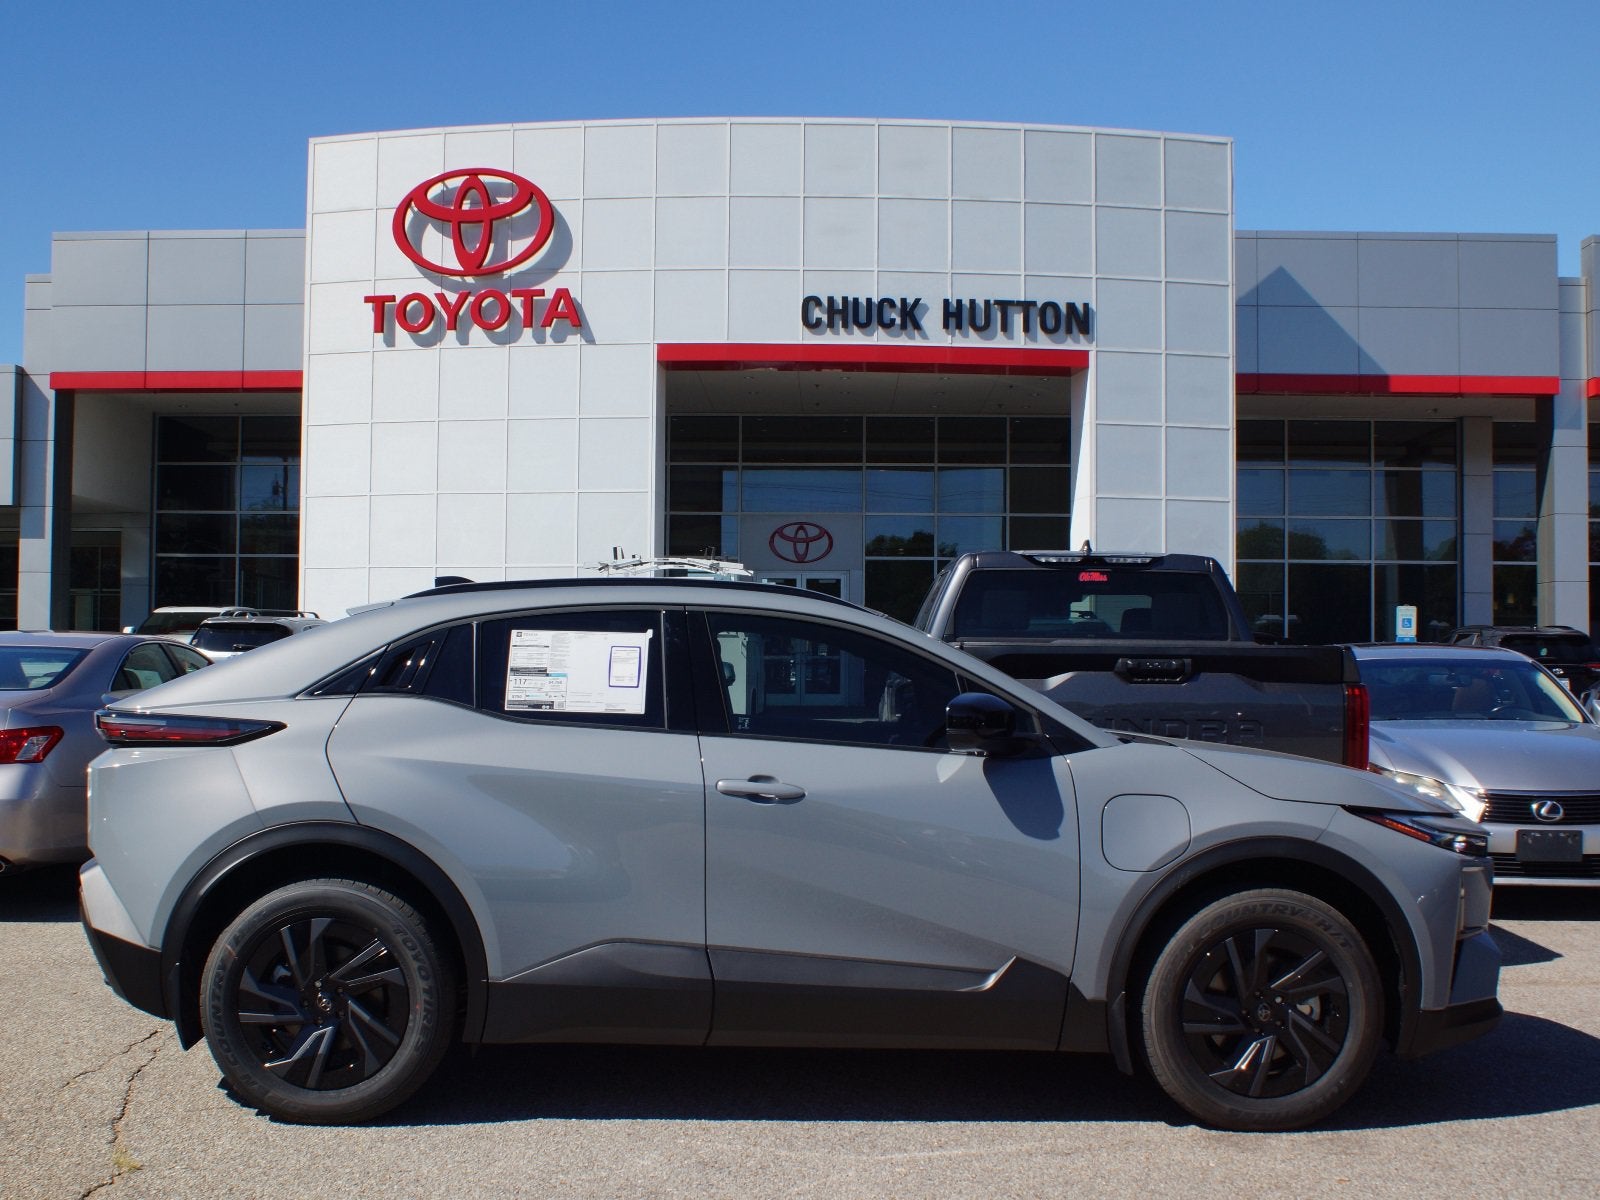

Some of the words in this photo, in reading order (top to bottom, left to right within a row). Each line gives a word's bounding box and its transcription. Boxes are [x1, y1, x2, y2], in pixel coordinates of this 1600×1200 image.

[363, 287, 582, 333] TOYOTA
[801, 295, 922, 331] CHUCK
[942, 298, 1090, 335] HUTTON
